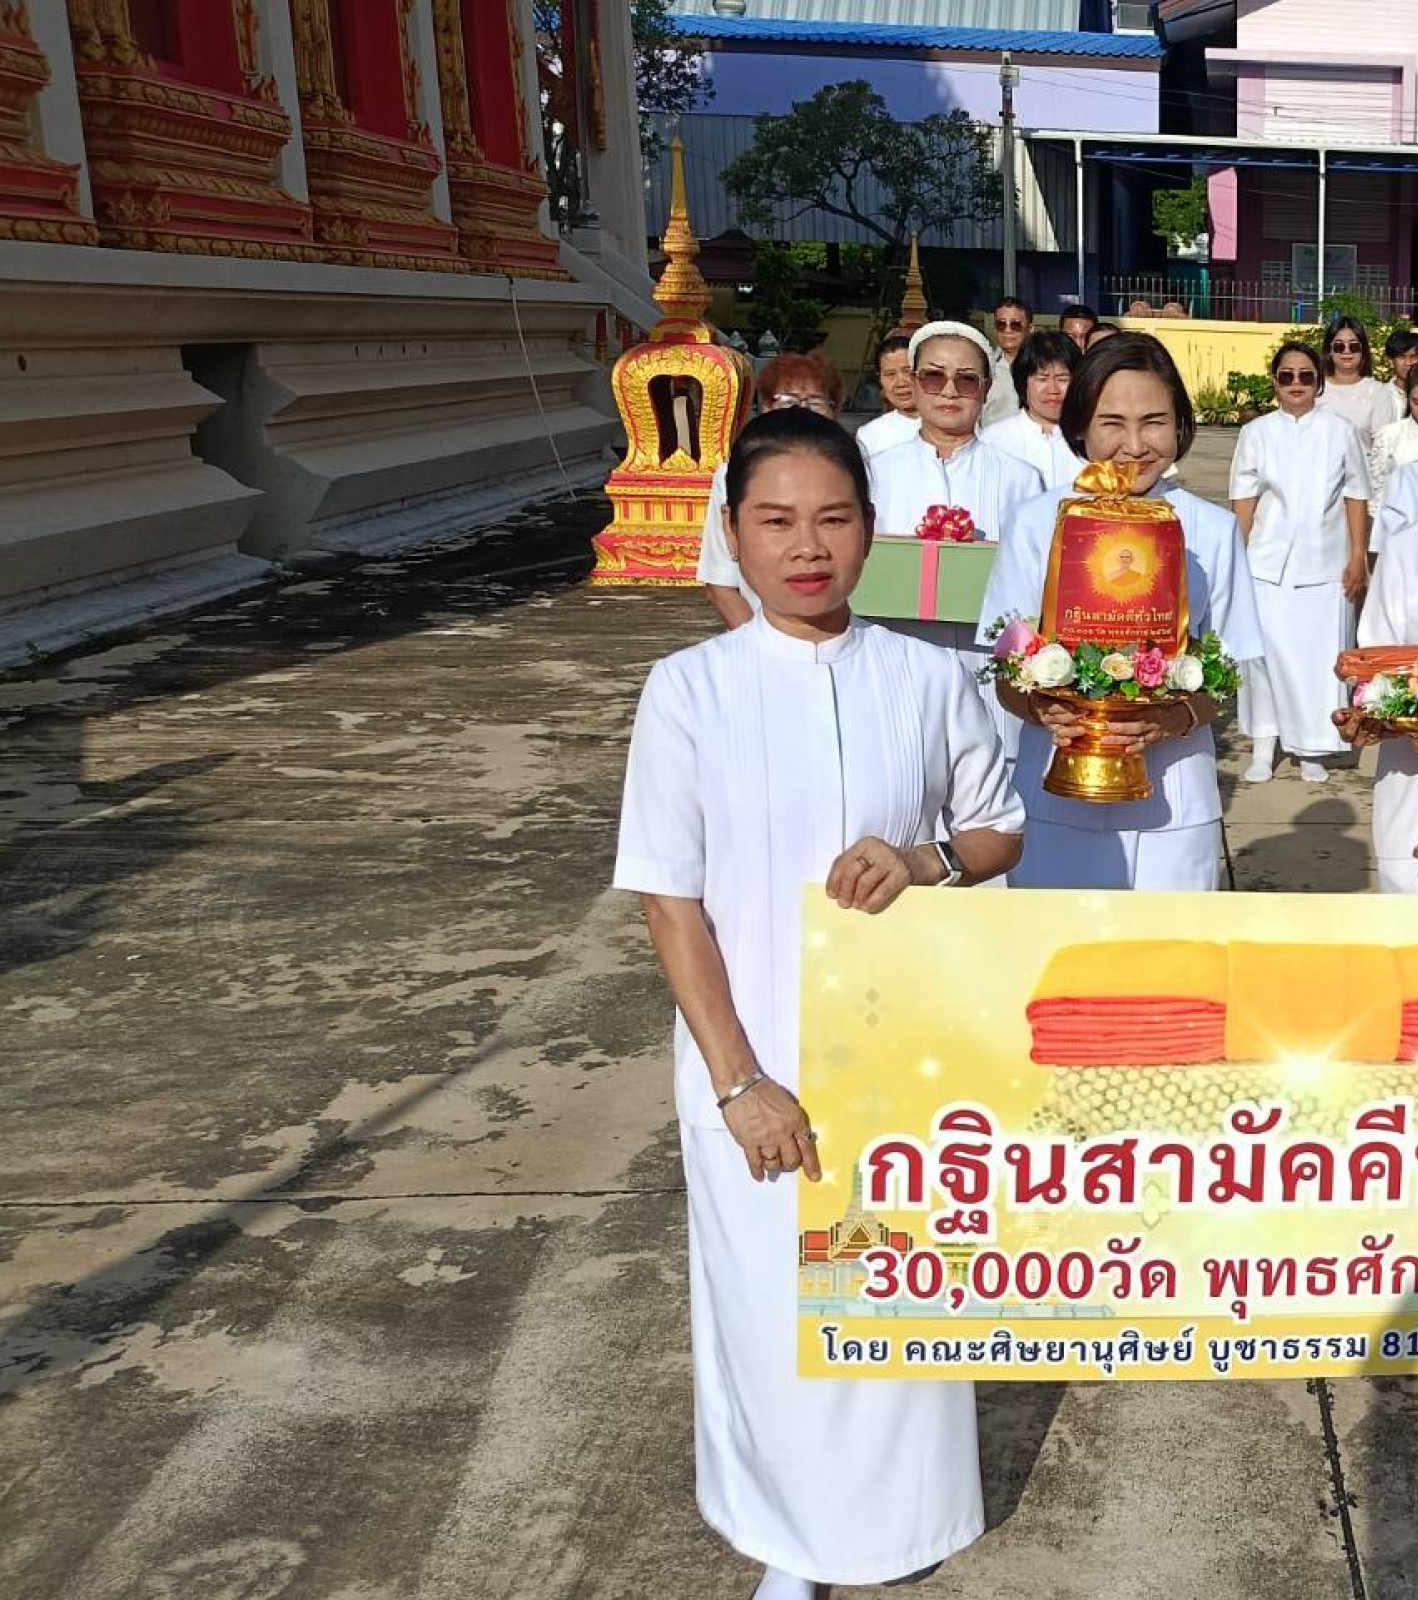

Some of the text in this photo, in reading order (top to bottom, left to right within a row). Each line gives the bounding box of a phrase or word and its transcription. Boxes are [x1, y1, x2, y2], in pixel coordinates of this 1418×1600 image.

[866, 1236, 1177, 1308] 30,000วัด
[821, 1327, 889, 1362] โดย
[904, 1326, 1195, 1374] คณะศิษยานุศิษย์
[1208, 1335, 1367, 1373] บูชาธรรม
